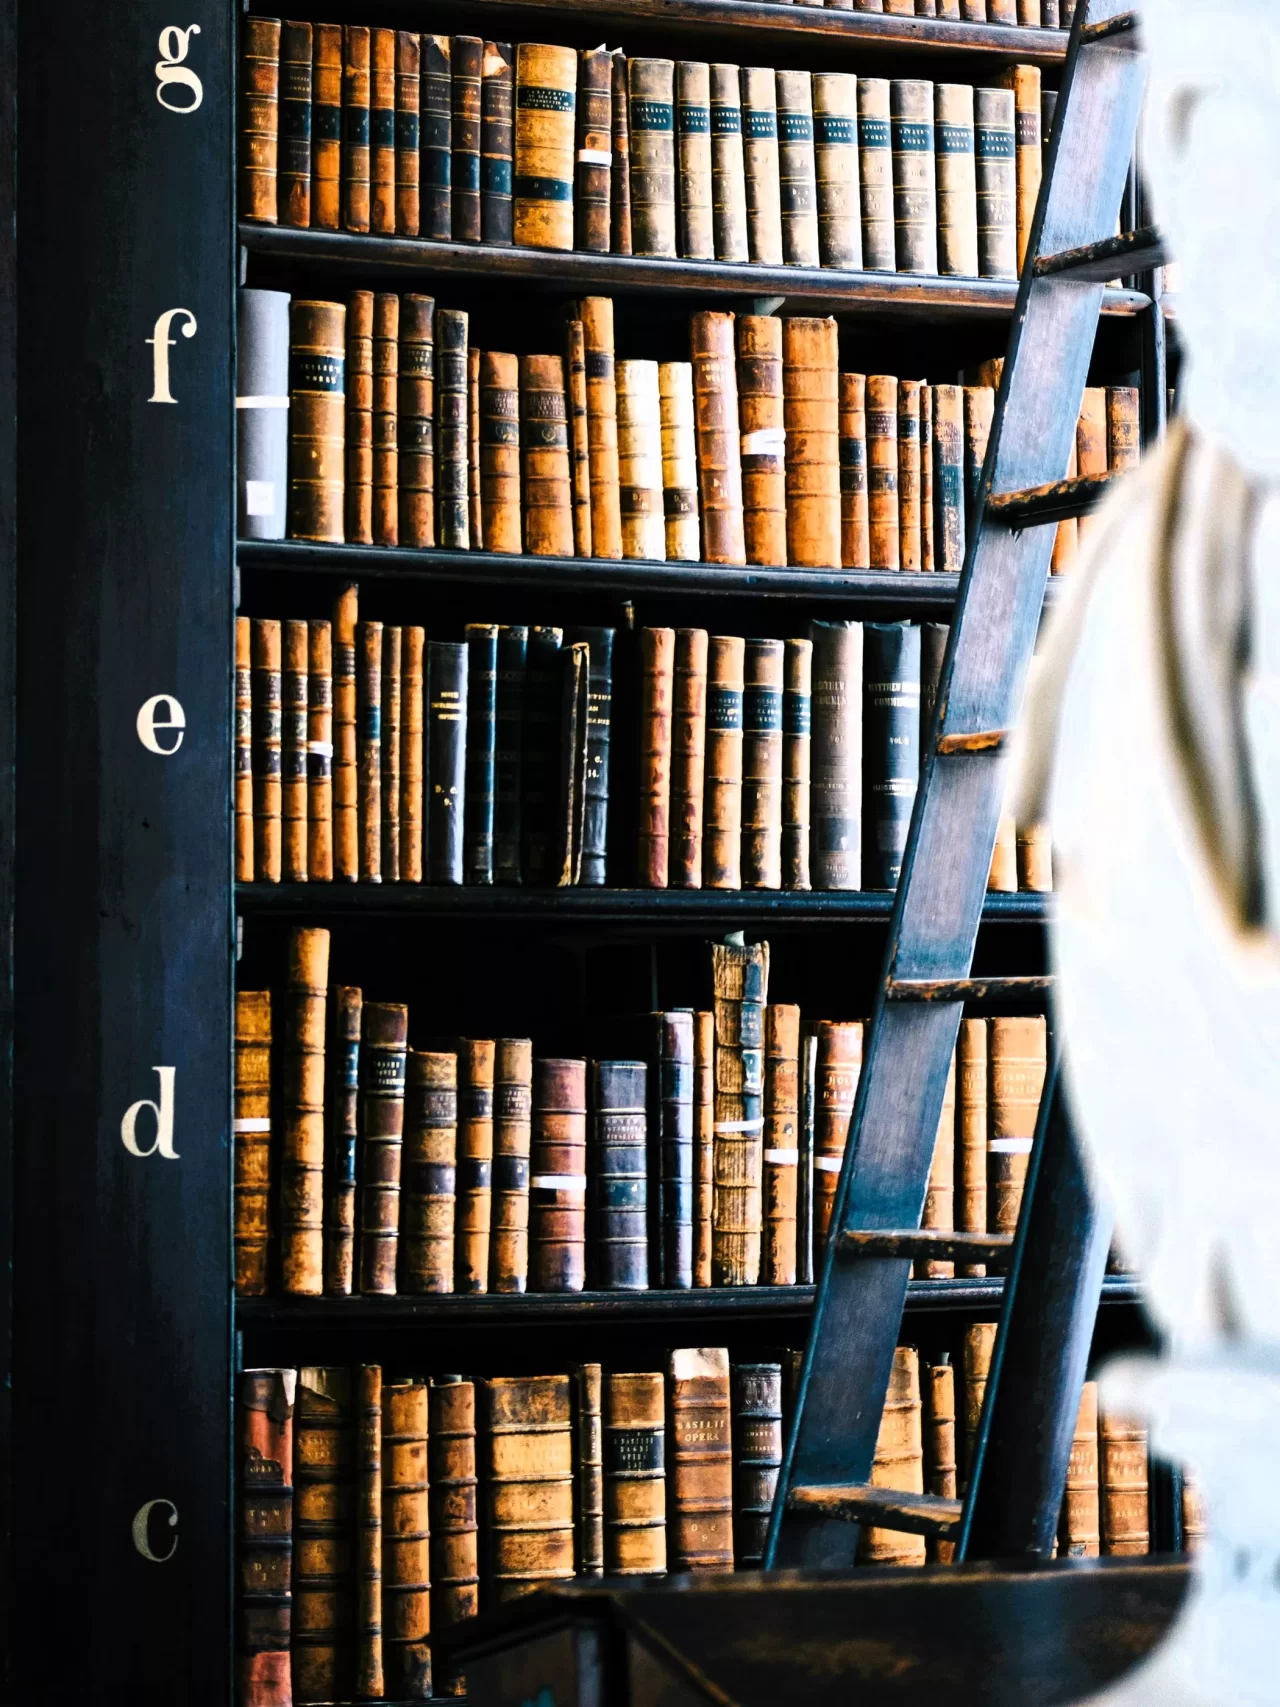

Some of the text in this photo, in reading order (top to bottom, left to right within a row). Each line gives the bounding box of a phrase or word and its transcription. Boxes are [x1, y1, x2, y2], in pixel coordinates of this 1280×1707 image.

[154, 23, 204, 115] g
[144, 307, 198, 404] f
[136, 693, 187, 756] e
[120, 1065, 182, 1160] d
[684, 1432, 720, 1443] OPERA
[132, 1498, 179, 1563] c
